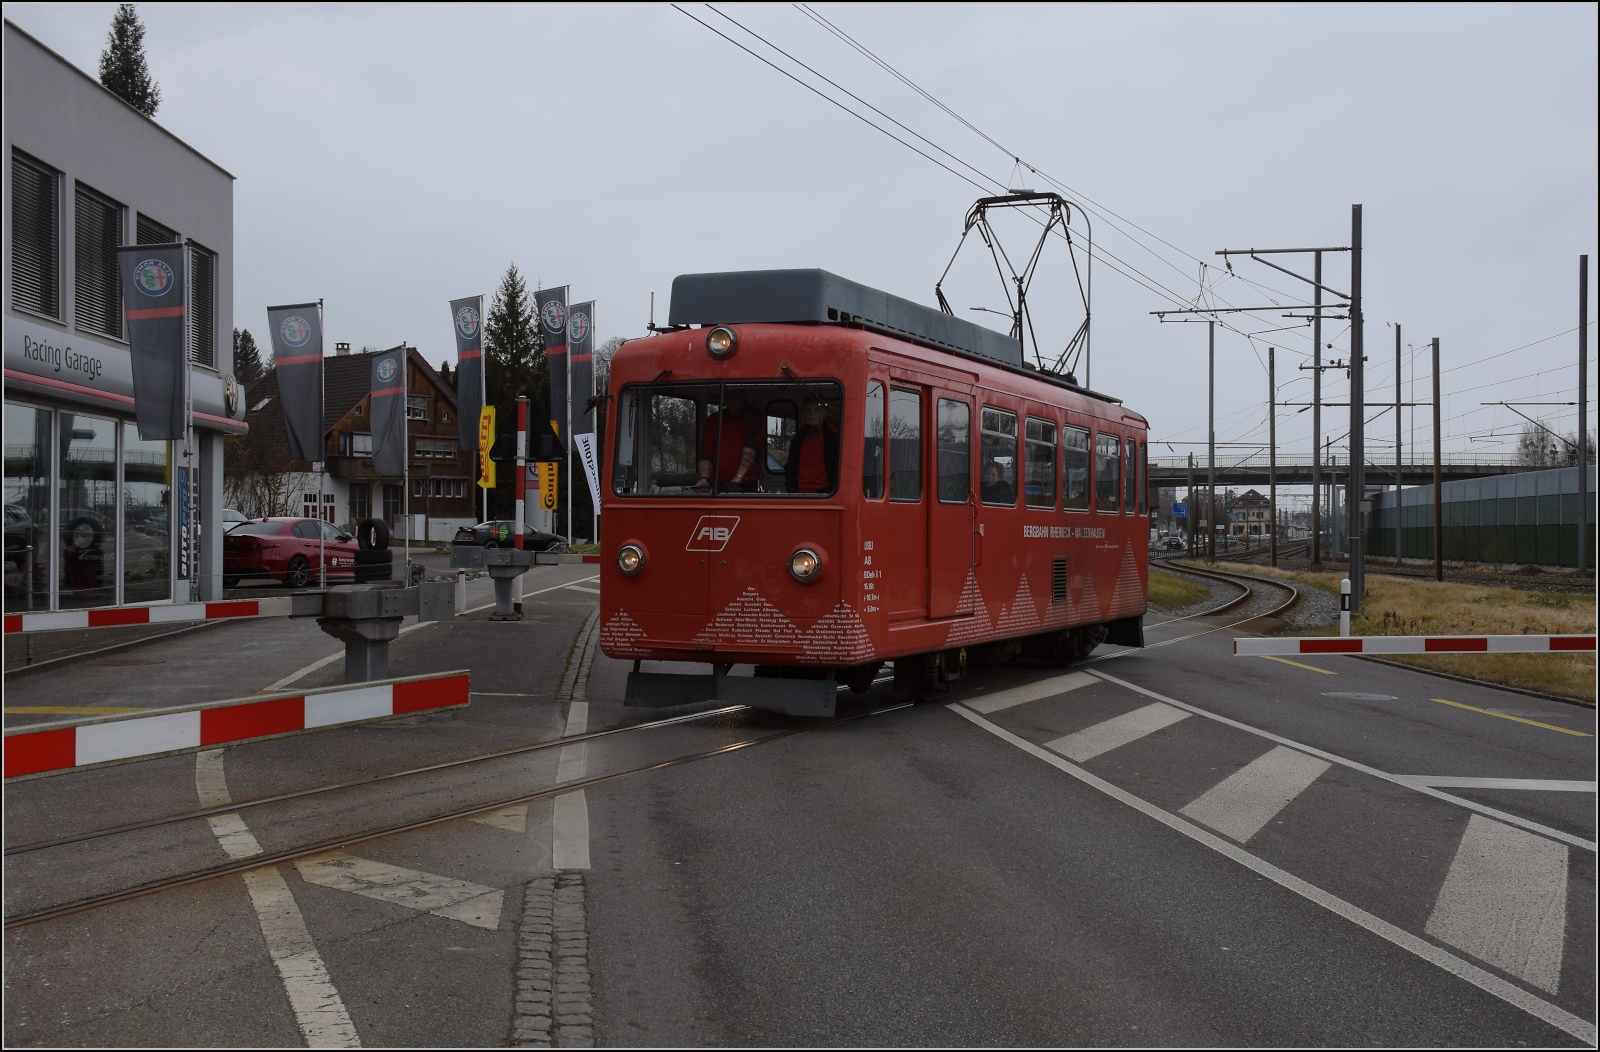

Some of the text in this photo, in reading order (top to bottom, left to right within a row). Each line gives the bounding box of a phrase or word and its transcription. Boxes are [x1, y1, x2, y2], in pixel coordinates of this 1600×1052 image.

[24, 335, 102, 381] Racing Garage
[696, 526, 730, 541] AB
[1023, 525, 1048, 538] BERGBAHN
[1050, 526, 1072, 539] RHEINECK
[1075, 527, 1106, 539] WALZENHAUSEN
[863, 556, 872, 565] AB
